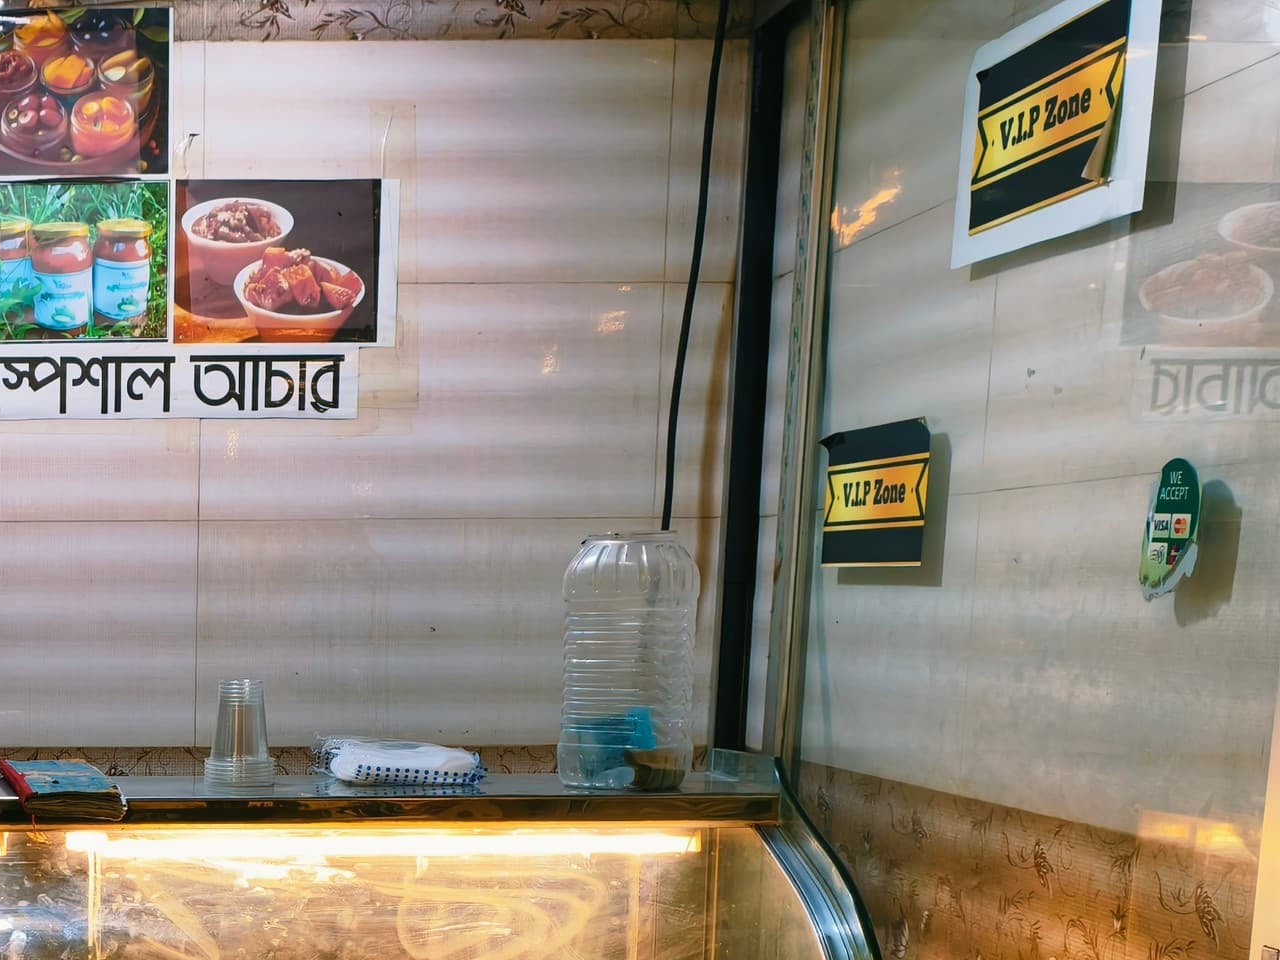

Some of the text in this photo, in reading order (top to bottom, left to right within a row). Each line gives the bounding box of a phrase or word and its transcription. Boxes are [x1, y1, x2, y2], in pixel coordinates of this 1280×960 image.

[1000, 88, 1091, 150] V.I.P Zone
[189, 354, 346, 413] আচার
[1170, 471, 1183, 484] WE
[843, 479, 906, 508] V.I.P Zone
[1160, 486, 1190, 500] ACCEPT
[1154, 520, 1168, 532] VISA
